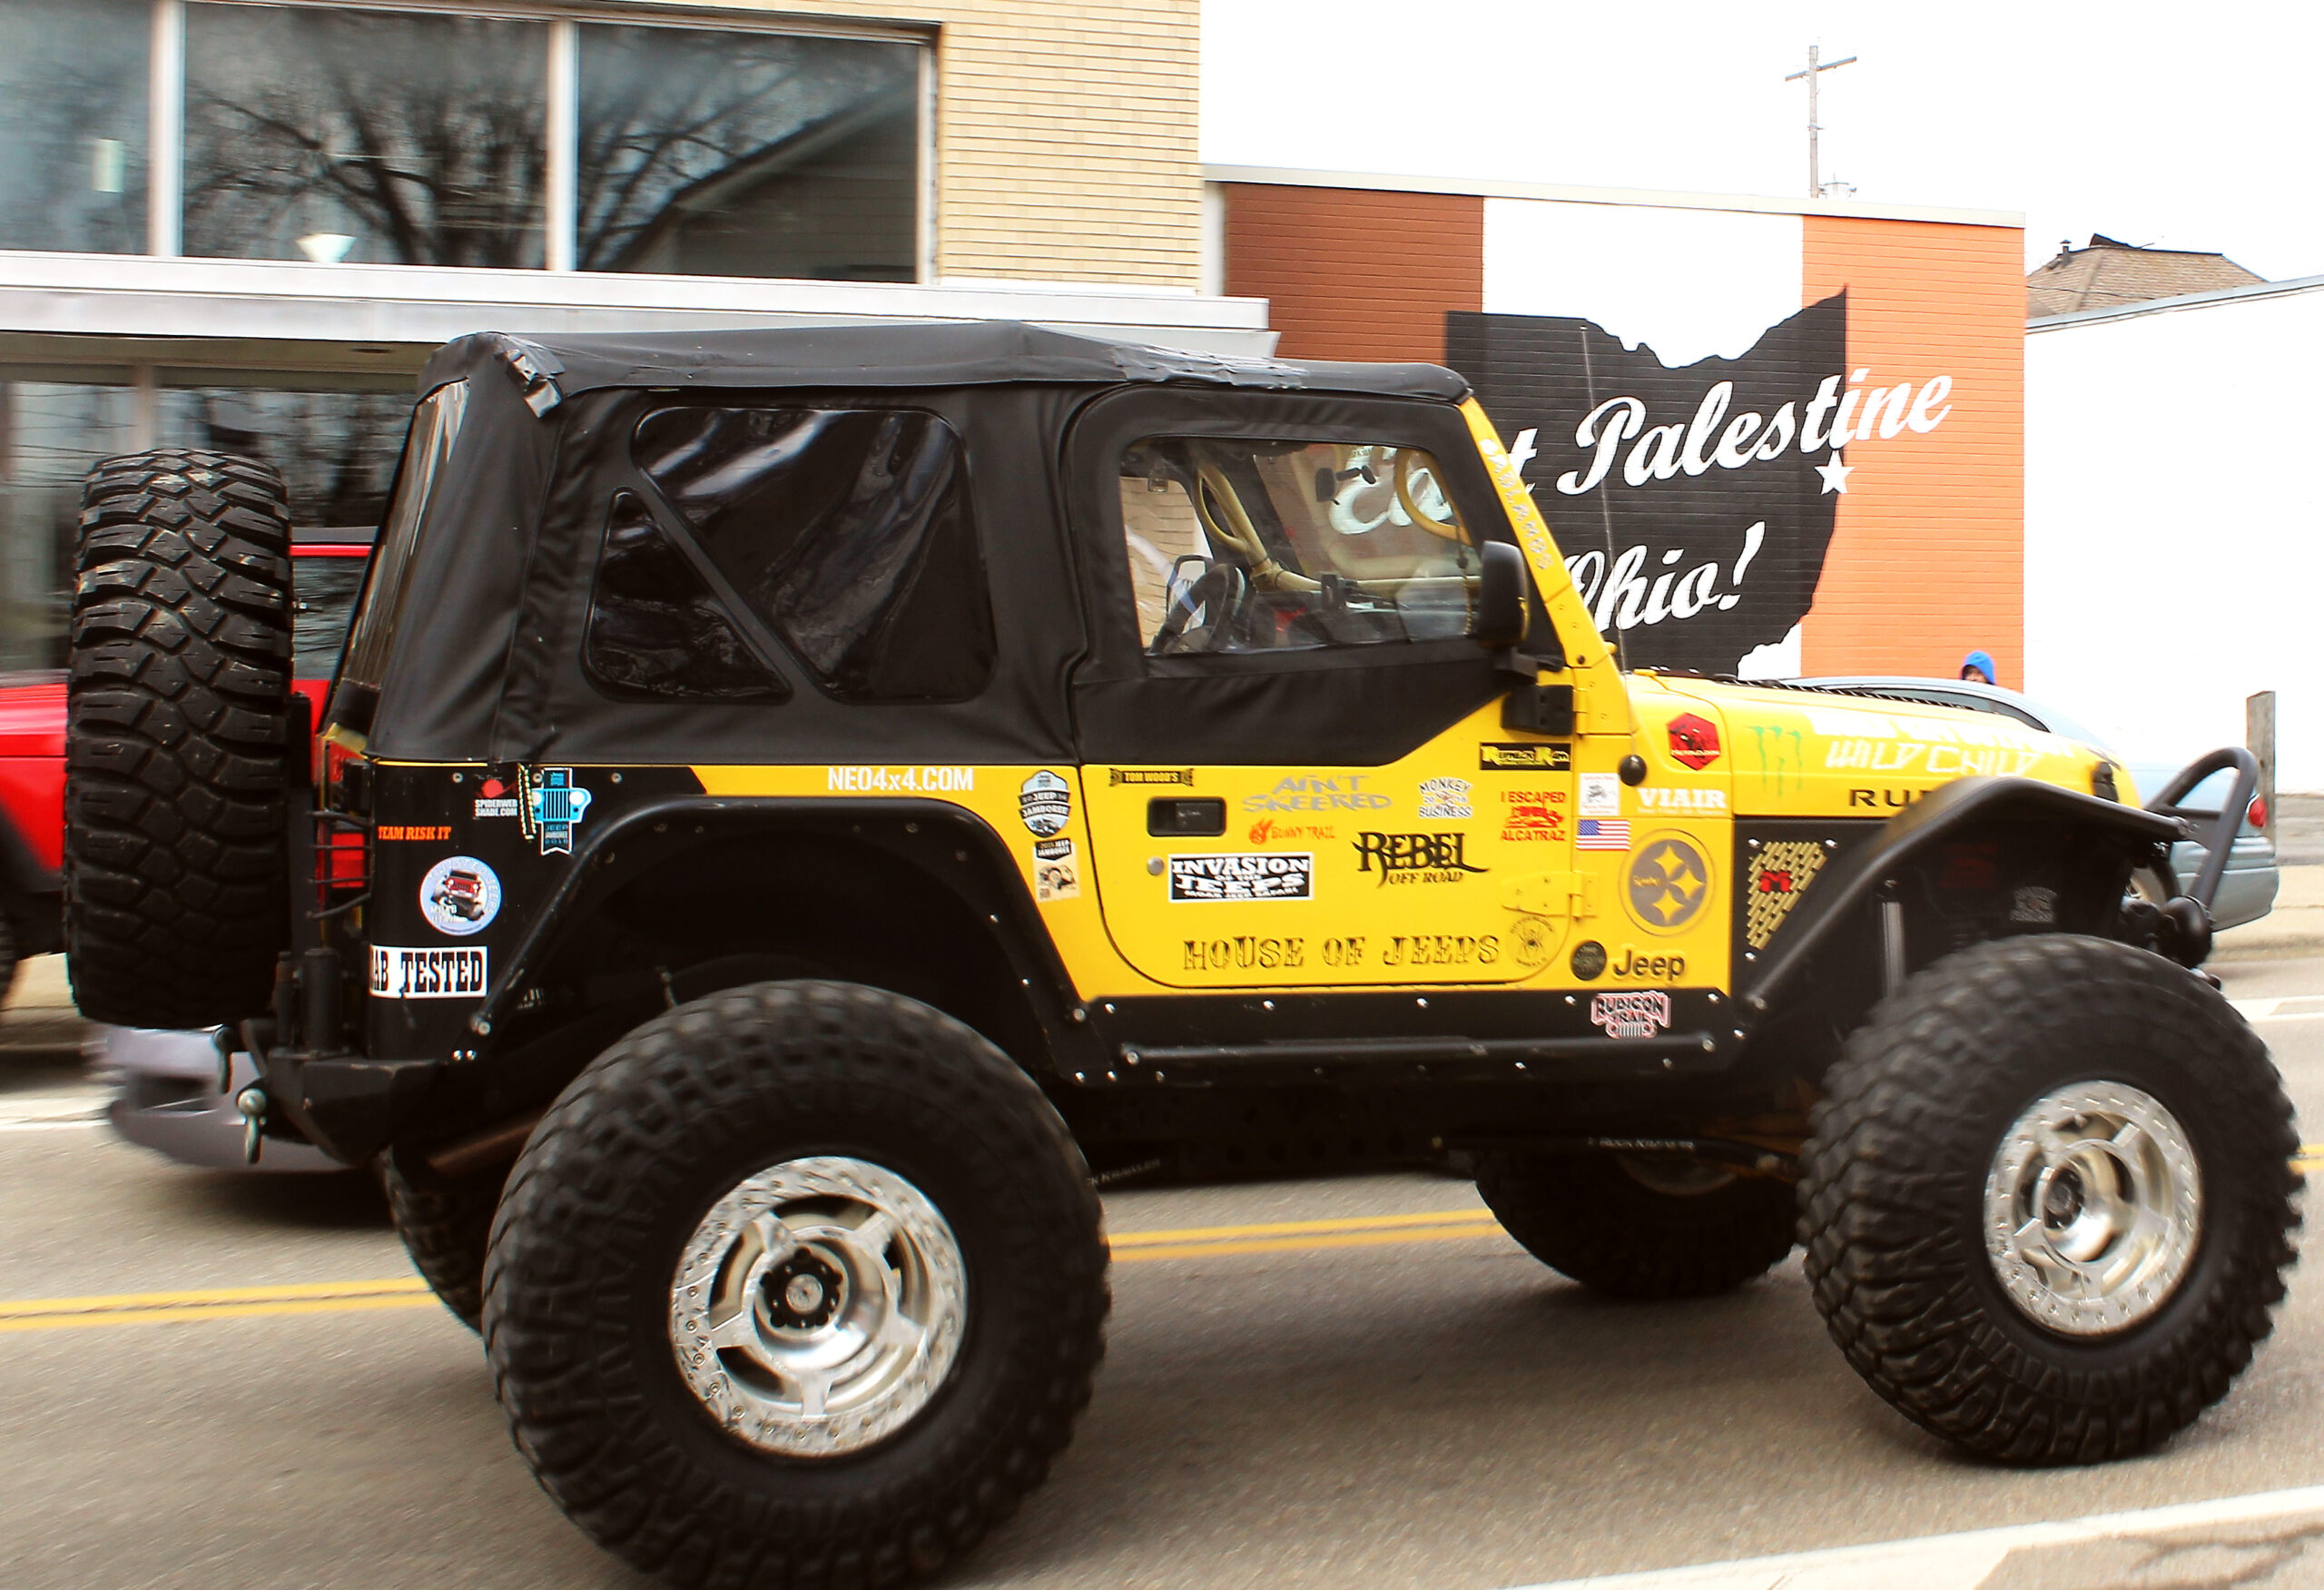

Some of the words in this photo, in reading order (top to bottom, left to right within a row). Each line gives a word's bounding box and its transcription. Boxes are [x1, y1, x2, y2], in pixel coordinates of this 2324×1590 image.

[1556, 368, 1953, 496] Palestine
[1567, 520, 1765, 634] Ohio!
[1825, 740, 1925, 769] WILD
[1926, 745, 2041, 775] CHILD
[828, 766, 973, 791] NEO4x4.COM
[1272, 775, 1370, 795] AIN'T
[1419, 778, 1472, 795] MONKEY
[475, 799, 518, 807] SPIDERWEB
[1242, 794, 1393, 814] SKEERED
[1501, 791, 1505, 803] I
[1508, 791, 1566, 804] ESCAPED
[1637, 787, 1727, 808] VIAIR
[1849, 789, 1934, 807] RU
[475, 807, 518, 816] SHADE.COM
[1021, 805, 1068, 817] JAMBOREE
[1418, 805, 1472, 817] BUSINESS
[378, 825, 404, 840] TEAM
[405, 825, 436, 840] RISK
[437, 825, 452, 840] IT
[1501, 830, 1566, 842] ALCATRAZ
[1172, 856, 1309, 875] INVASION
[1351, 831, 1490, 889] REBEL
[1176, 873, 1305, 894] JEEPS
[1389, 873, 1419, 884] OFF
[1423, 872, 1463, 884] ROAD
[1183, 936, 1305, 970] HOUSE
[1322, 936, 1365, 967] OF
[1383, 935, 1501, 966] JEEPS
[400, 950, 484, 993] TESTED
[1612, 949, 1685, 981] Jeep
[1591, 991, 1670, 1027] RUBICON
